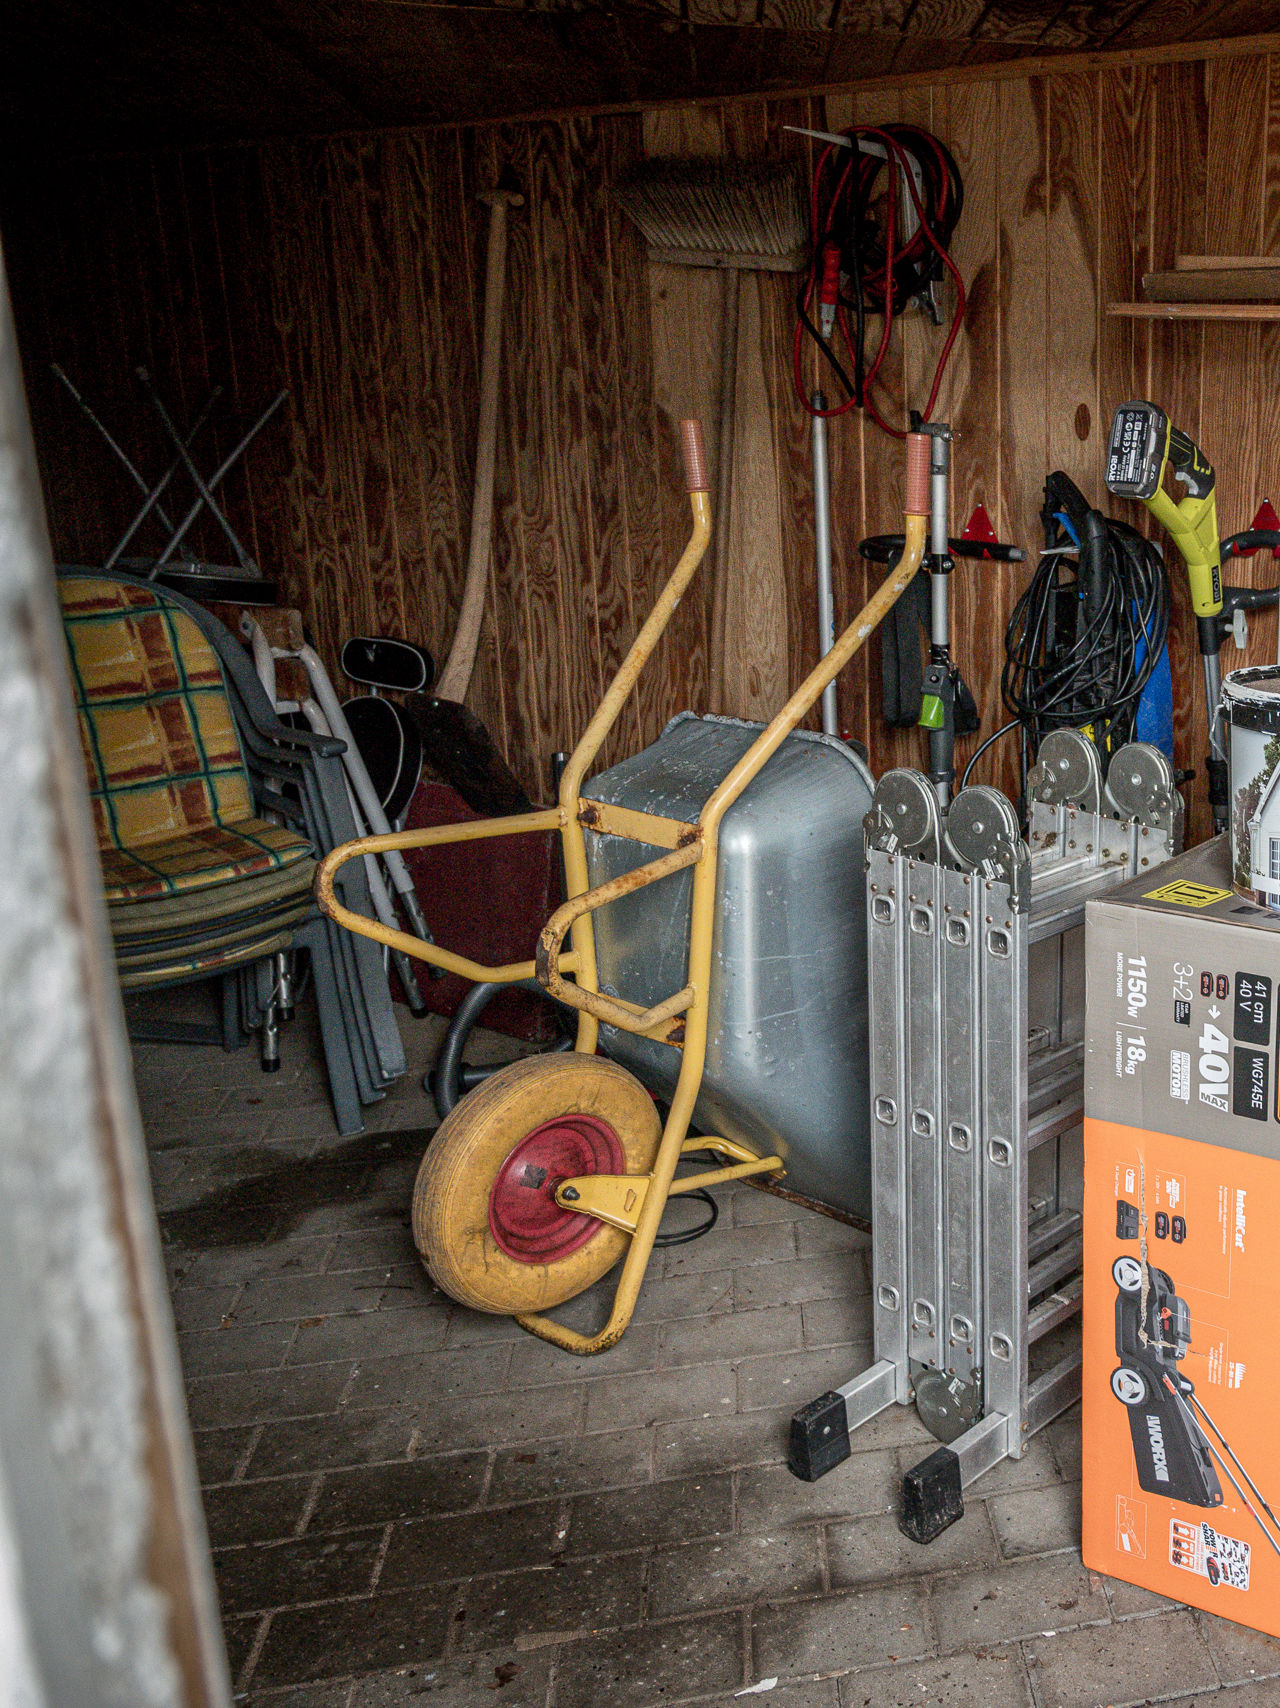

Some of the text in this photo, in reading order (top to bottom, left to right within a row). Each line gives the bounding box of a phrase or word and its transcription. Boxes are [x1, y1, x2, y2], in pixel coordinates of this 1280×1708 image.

[1108, 455, 1119, 482] RYOBI
[1212, 568, 1220, 602] RYOBI
[1116, 951, 1124, 974] MORE
[1173, 961, 1194, 1001] 3+2
[1239, 979, 1252, 1013] 40 V
[1253, 980, 1267, 1025] 41 cm
[1115, 1030, 1123, 1078] LIGHTWEIGHT
[1171, 1051, 1182, 1098] MOTOR
[1182, 1053, 1190, 1099] BRUSHLESS
[1250, 1056, 1264, 1110] WG745E
[1200, 1091, 1228, 1111] MAX
[1147, 1416, 1170, 1483] WORX
